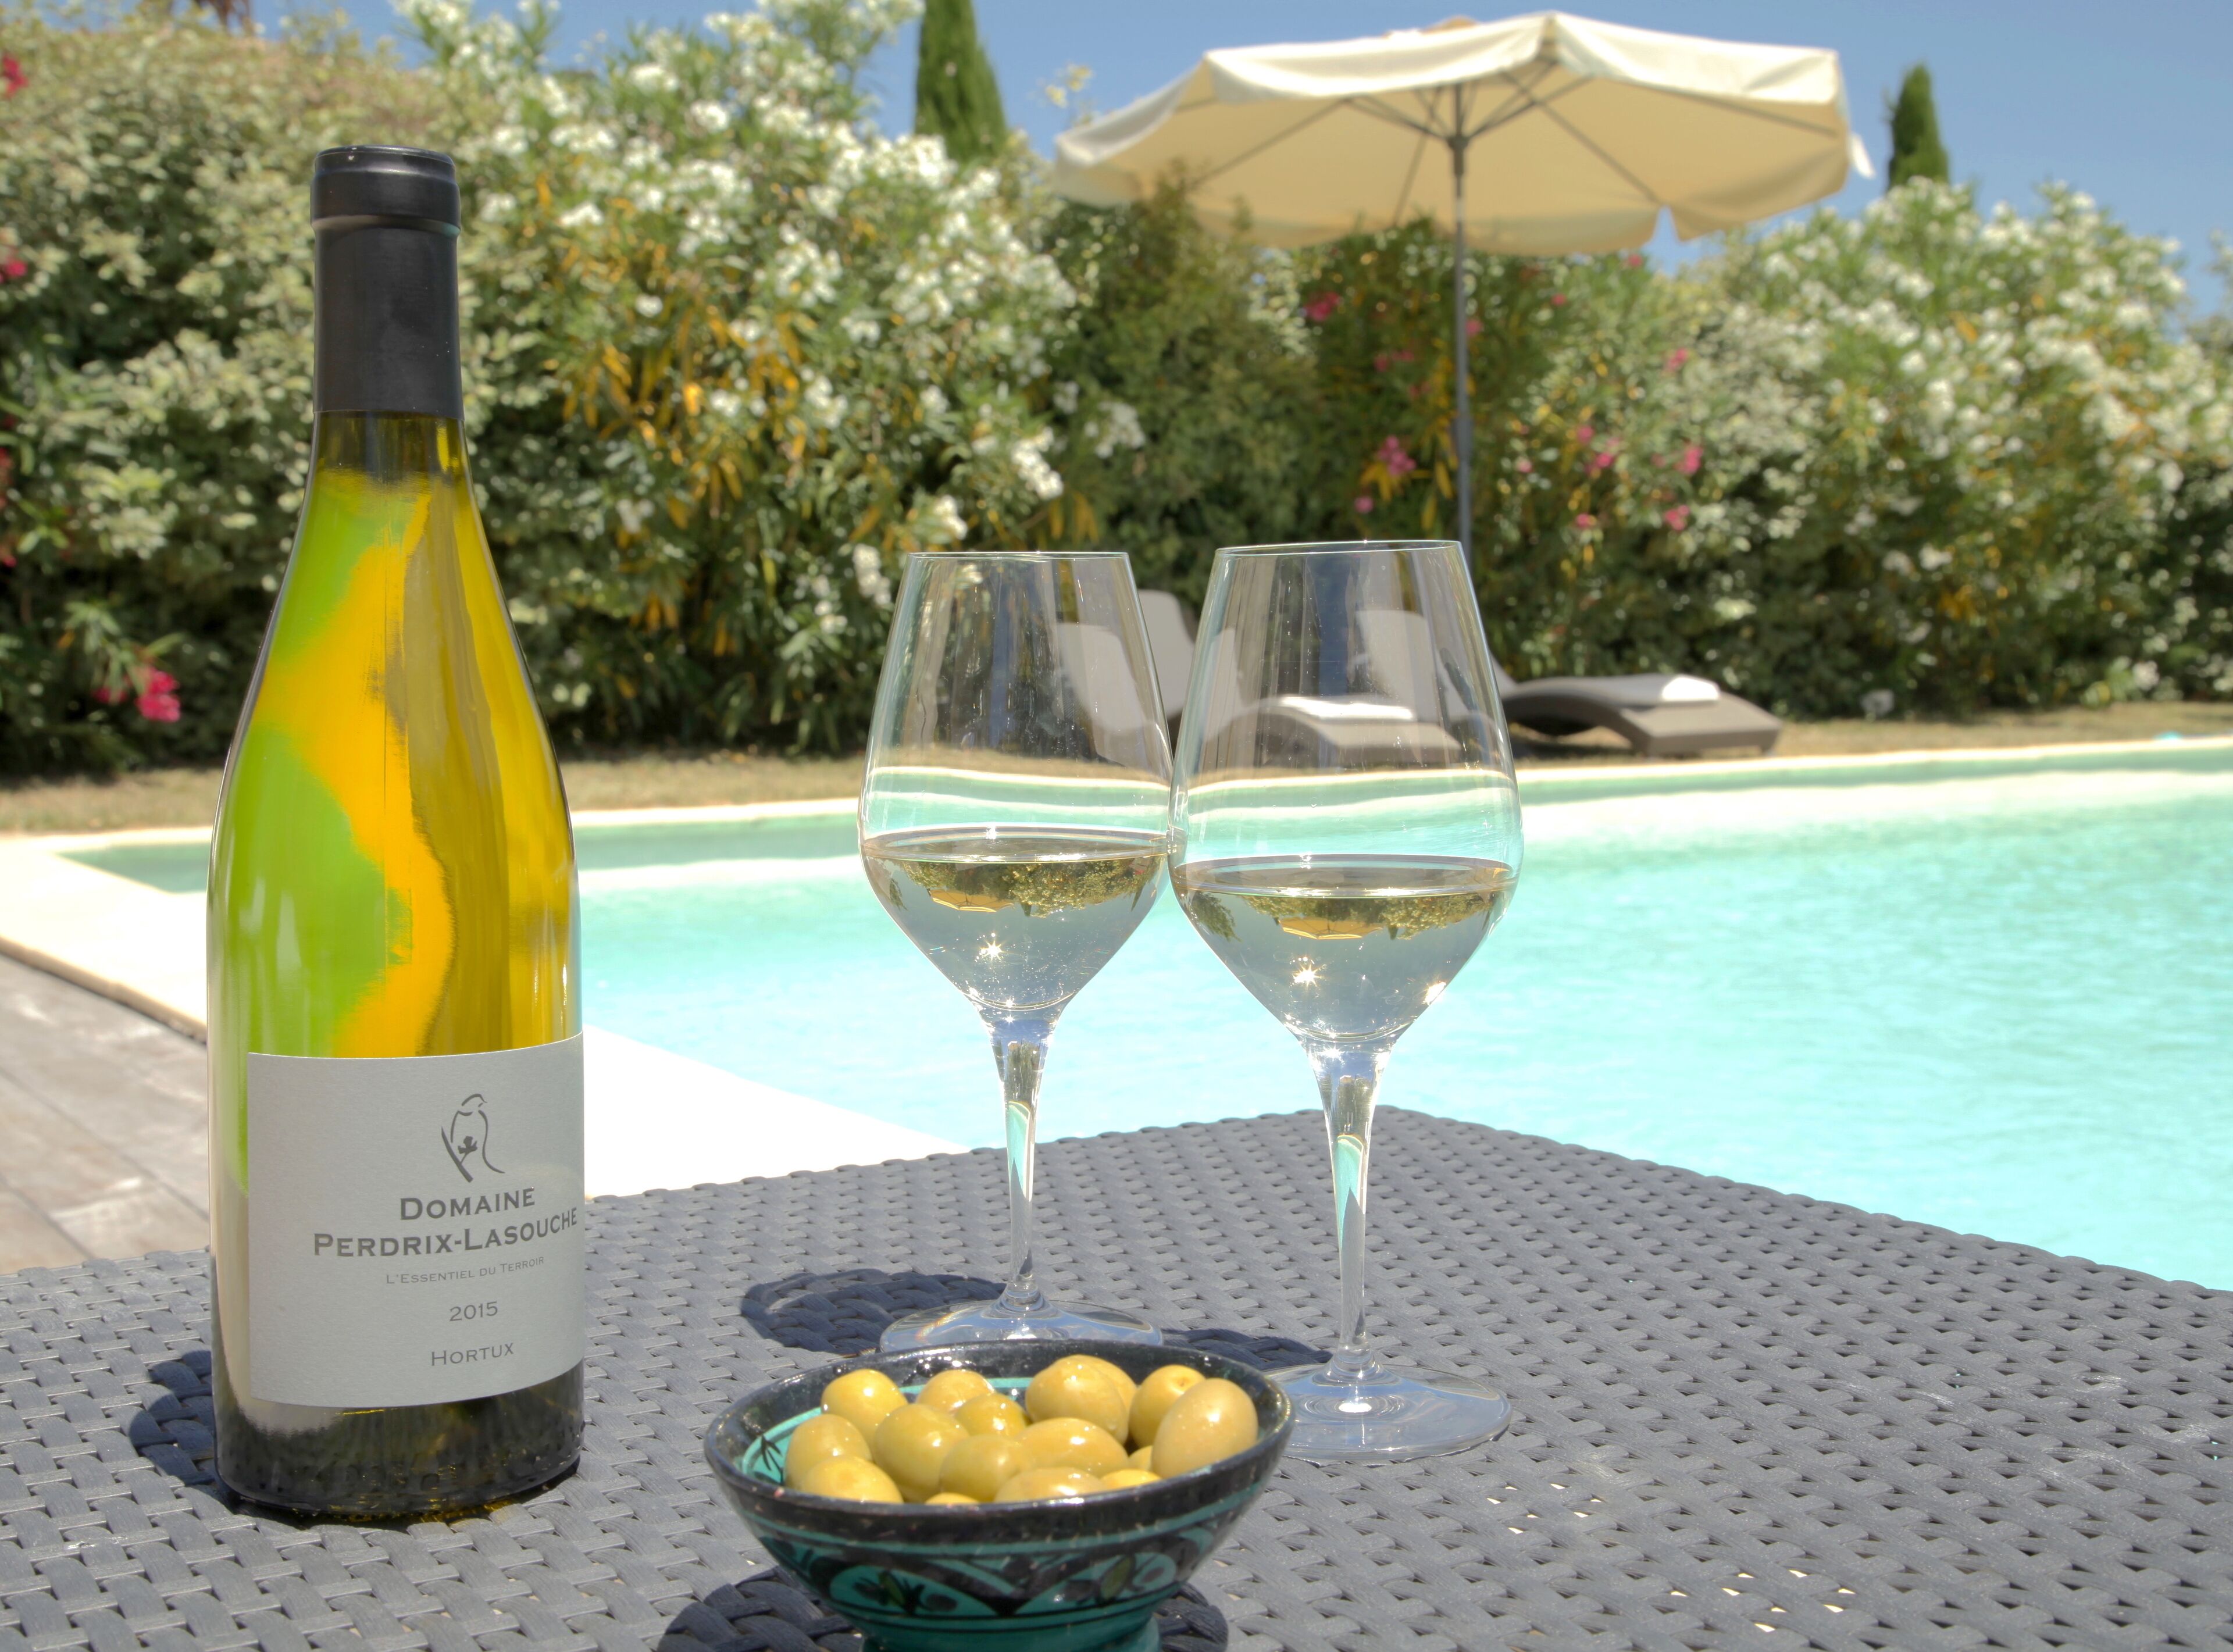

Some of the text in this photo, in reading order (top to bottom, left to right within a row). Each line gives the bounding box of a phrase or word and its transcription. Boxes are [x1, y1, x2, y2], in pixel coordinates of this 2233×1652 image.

[399, 1186, 536, 1221] DOMAINE
[313, 1207, 577, 1257] PERDRIX-LASOUCHE
[386, 1256, 544, 1284] L'ESSENTIEL DU TERROIR
[449, 1301, 498, 1322] 2015
[431, 1342, 514, 1366] HORTUX
